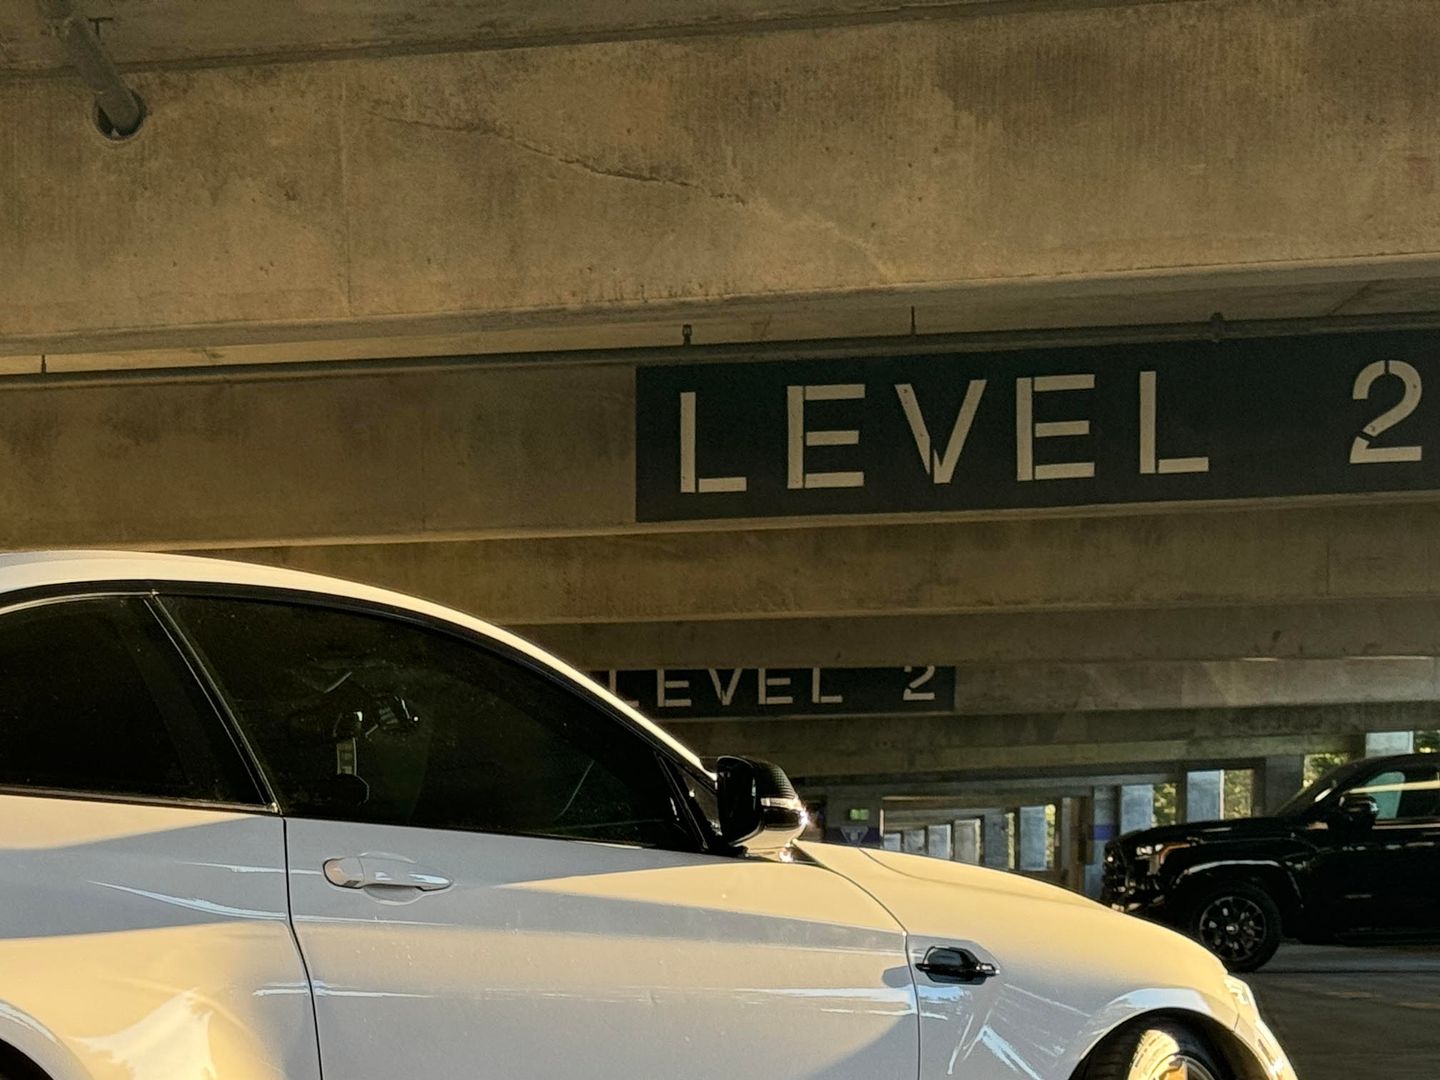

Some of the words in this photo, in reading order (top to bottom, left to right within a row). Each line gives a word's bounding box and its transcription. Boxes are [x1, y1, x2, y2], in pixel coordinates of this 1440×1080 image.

[679, 370, 1210, 494] LEVEL
[1348, 359, 1423, 464] 2
[610, 667, 843, 708] LEVEL
[902, 665, 936, 700] 2
